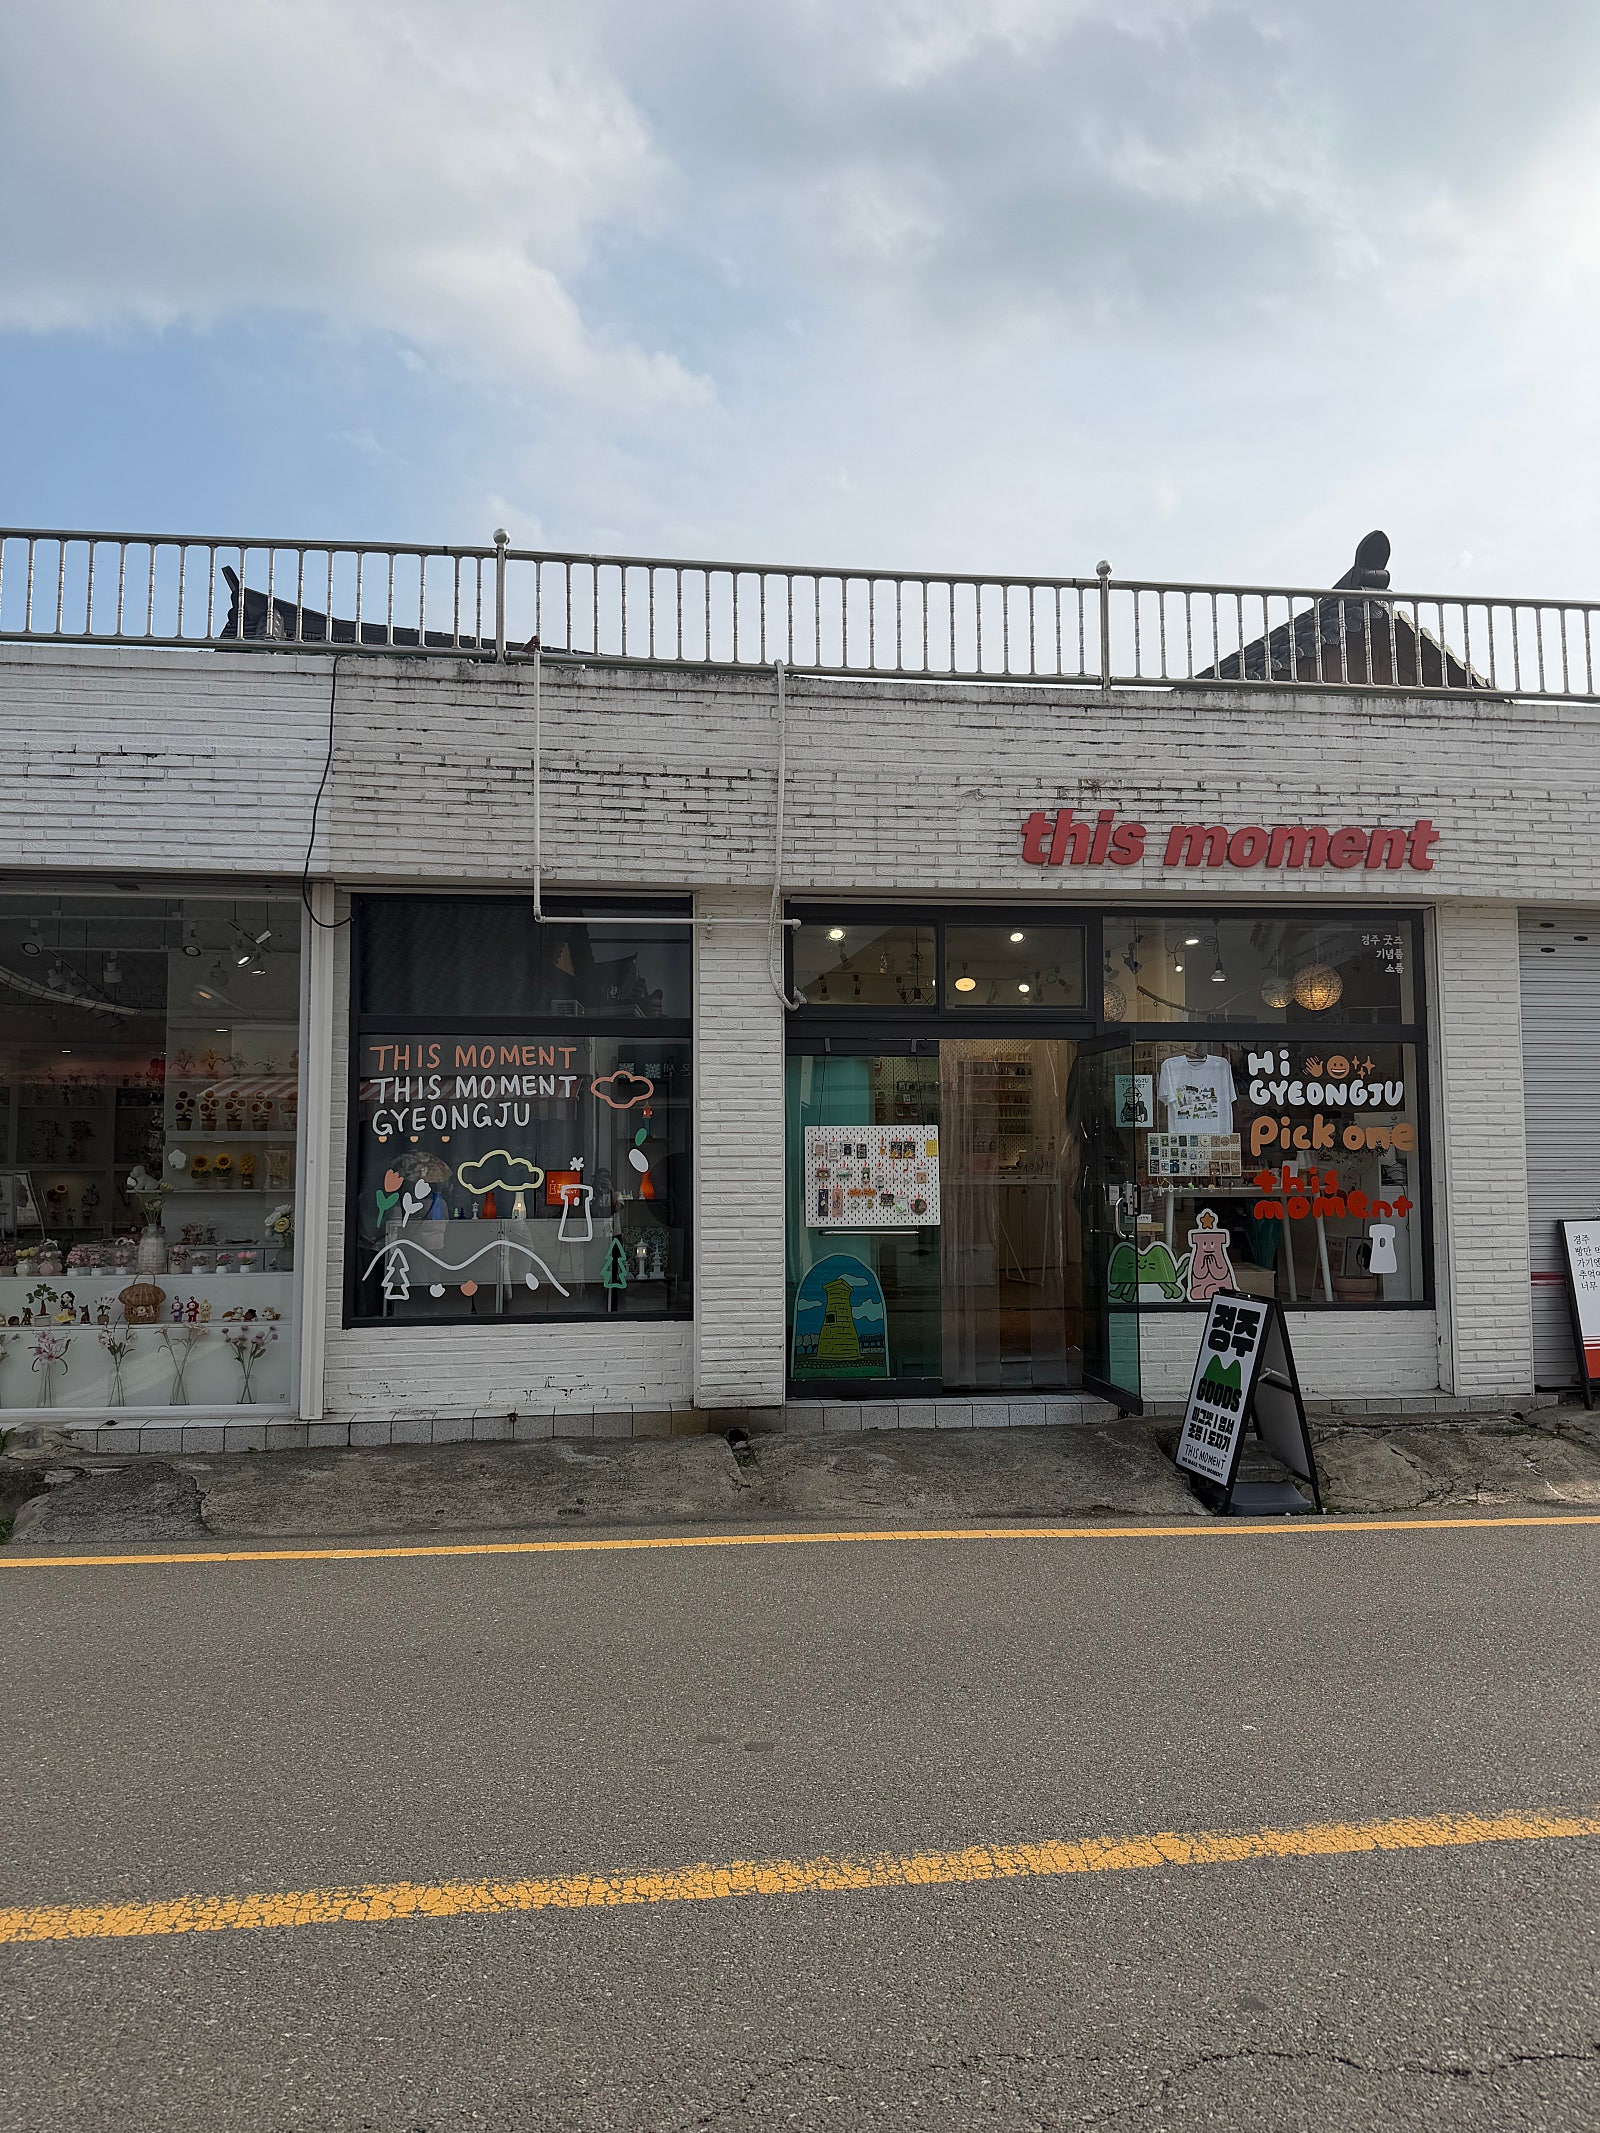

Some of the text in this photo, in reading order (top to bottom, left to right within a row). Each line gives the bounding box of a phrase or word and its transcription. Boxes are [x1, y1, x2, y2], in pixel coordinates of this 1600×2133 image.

[1021, 808, 1440, 871] this moment
[1361, 934, 1404, 946] 경주 굿즈
[1375, 948, 1404, 960] 기념품
[1384, 963, 1405, 974] 소품
[369, 1043, 577, 1071] THIS MOMENT
[1247, 1050, 1290, 1077] Hi
[369, 1075, 578, 1104] THIS MOMENT
[1249, 1079, 1404, 1106] GYEONGJU
[371, 1102, 530, 1135] GYEONGJU
[1342, 1123, 1415, 1151] one
[1253, 1165, 1339, 1194] this
[1254, 1190, 1413, 1220] moment
[1573, 1234, 1590, 1245] 경주
[1207, 1303, 1261, 1358] 경주
[1196, 1377, 1243, 1413] GOODS
[1187, 1422, 1231, 1452] 조명 도자기
[1218, 1415, 1235, 1435] 엽서
[1185, 1443, 1226, 1470] THIS MOMENT
